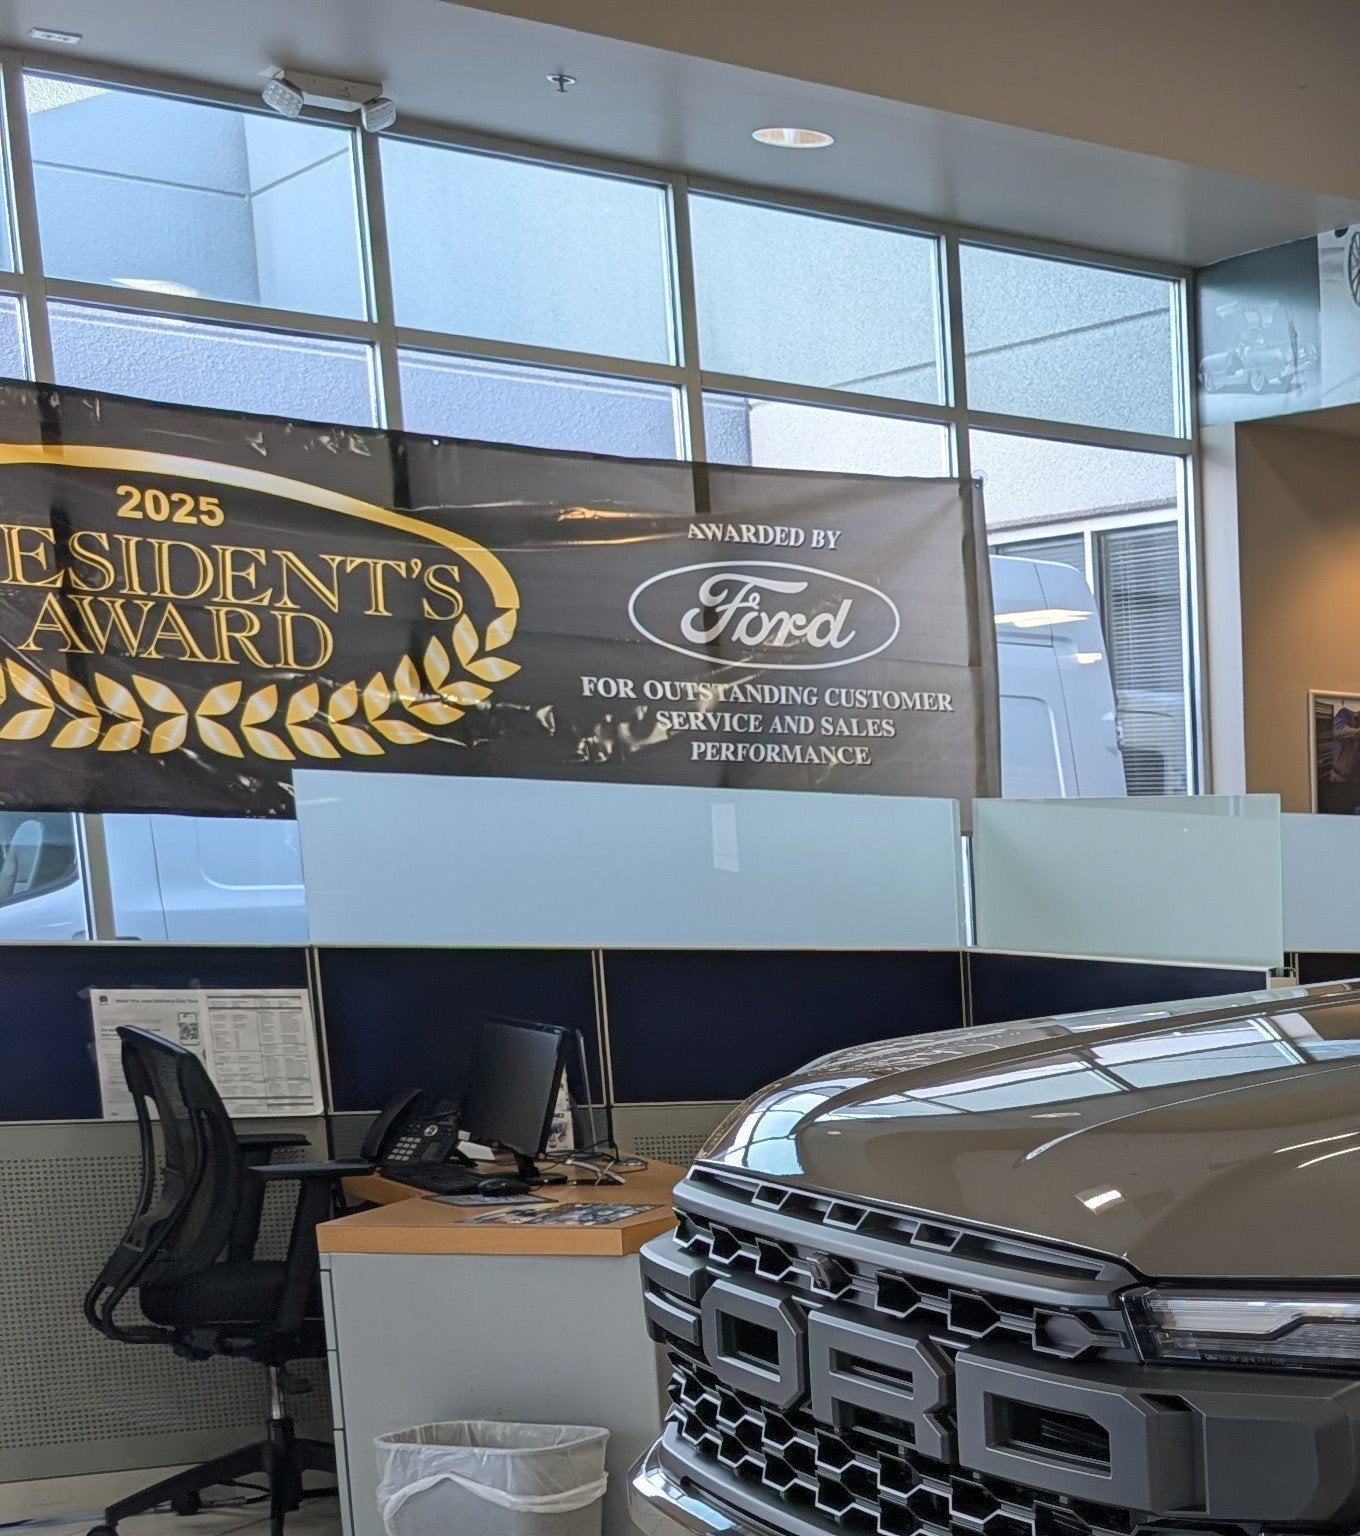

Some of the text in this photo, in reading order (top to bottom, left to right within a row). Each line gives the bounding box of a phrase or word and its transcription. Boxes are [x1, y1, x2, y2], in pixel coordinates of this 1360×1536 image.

[116, 485, 225, 527] 2025
[687, 522, 842, 550] AWARDED BY
[17, 591, 334, 671] AWARD
[680, 573, 856, 649] Ford
[581, 675, 954, 713] FOR OUTSTANDING CUSTOMER
[656, 710, 897, 738] SERVICE AND SALES
[690, 741, 873, 766] PERFORMANCE
[640, 1234, 1165, 1515] FORD
